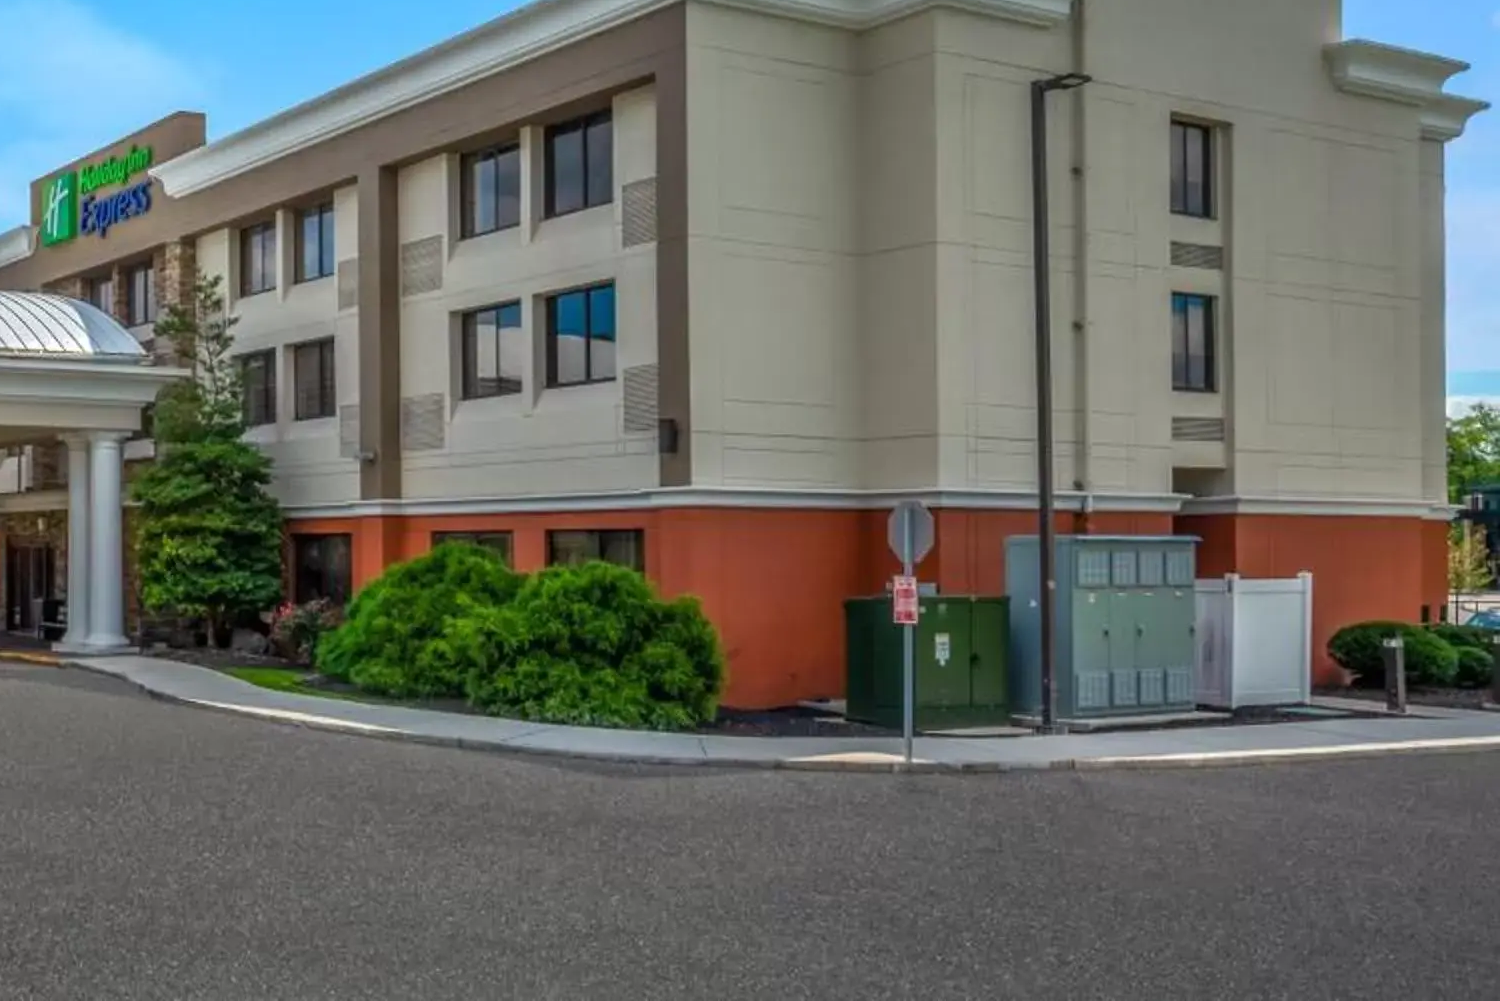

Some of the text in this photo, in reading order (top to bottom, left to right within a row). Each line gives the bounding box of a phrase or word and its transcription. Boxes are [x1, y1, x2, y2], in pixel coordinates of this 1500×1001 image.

[79, 147, 151, 195] Holiday Inn
[81, 182, 153, 238] Express
